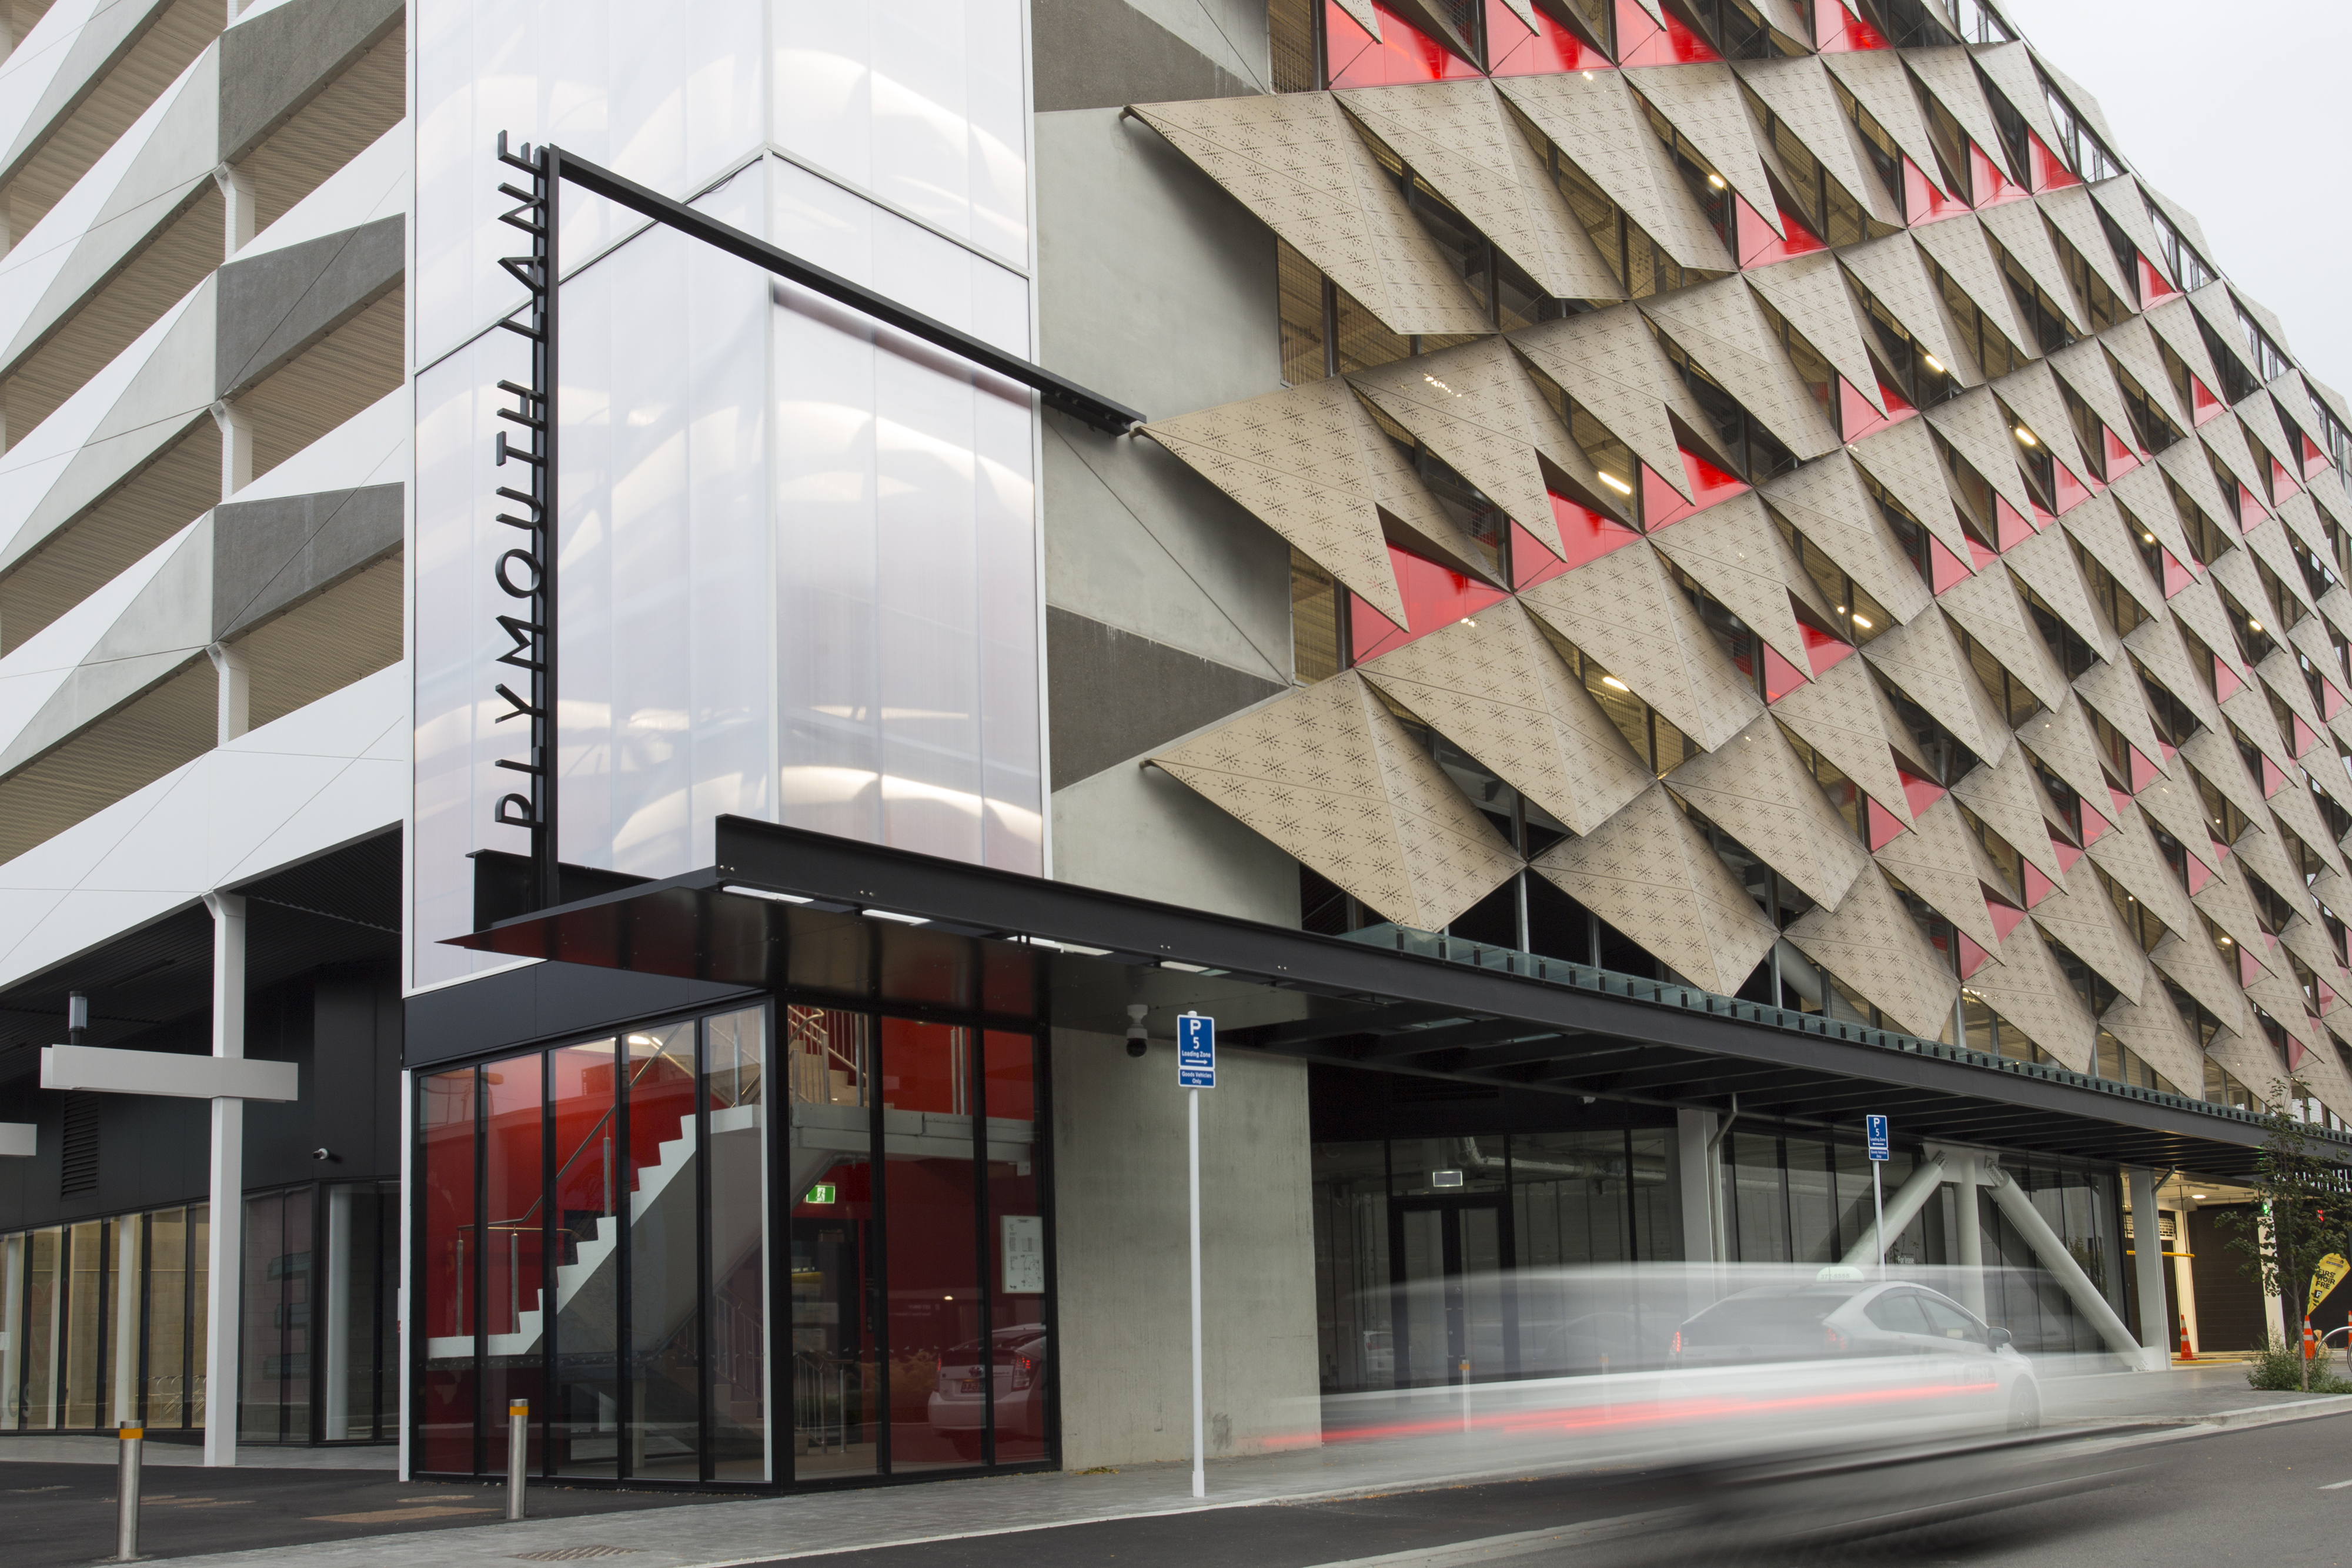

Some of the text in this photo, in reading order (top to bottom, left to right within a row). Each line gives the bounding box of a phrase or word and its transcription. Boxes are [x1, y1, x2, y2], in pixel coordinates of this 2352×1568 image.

[495, 129, 550, 830] PLYMOUTH LANE
[1190, 1019, 1201, 1035] P
[1193, 1037, 1200, 1049] 5
[1873, 1118, 1880, 1128] P
[1876, 1128, 1879, 1136] 5
